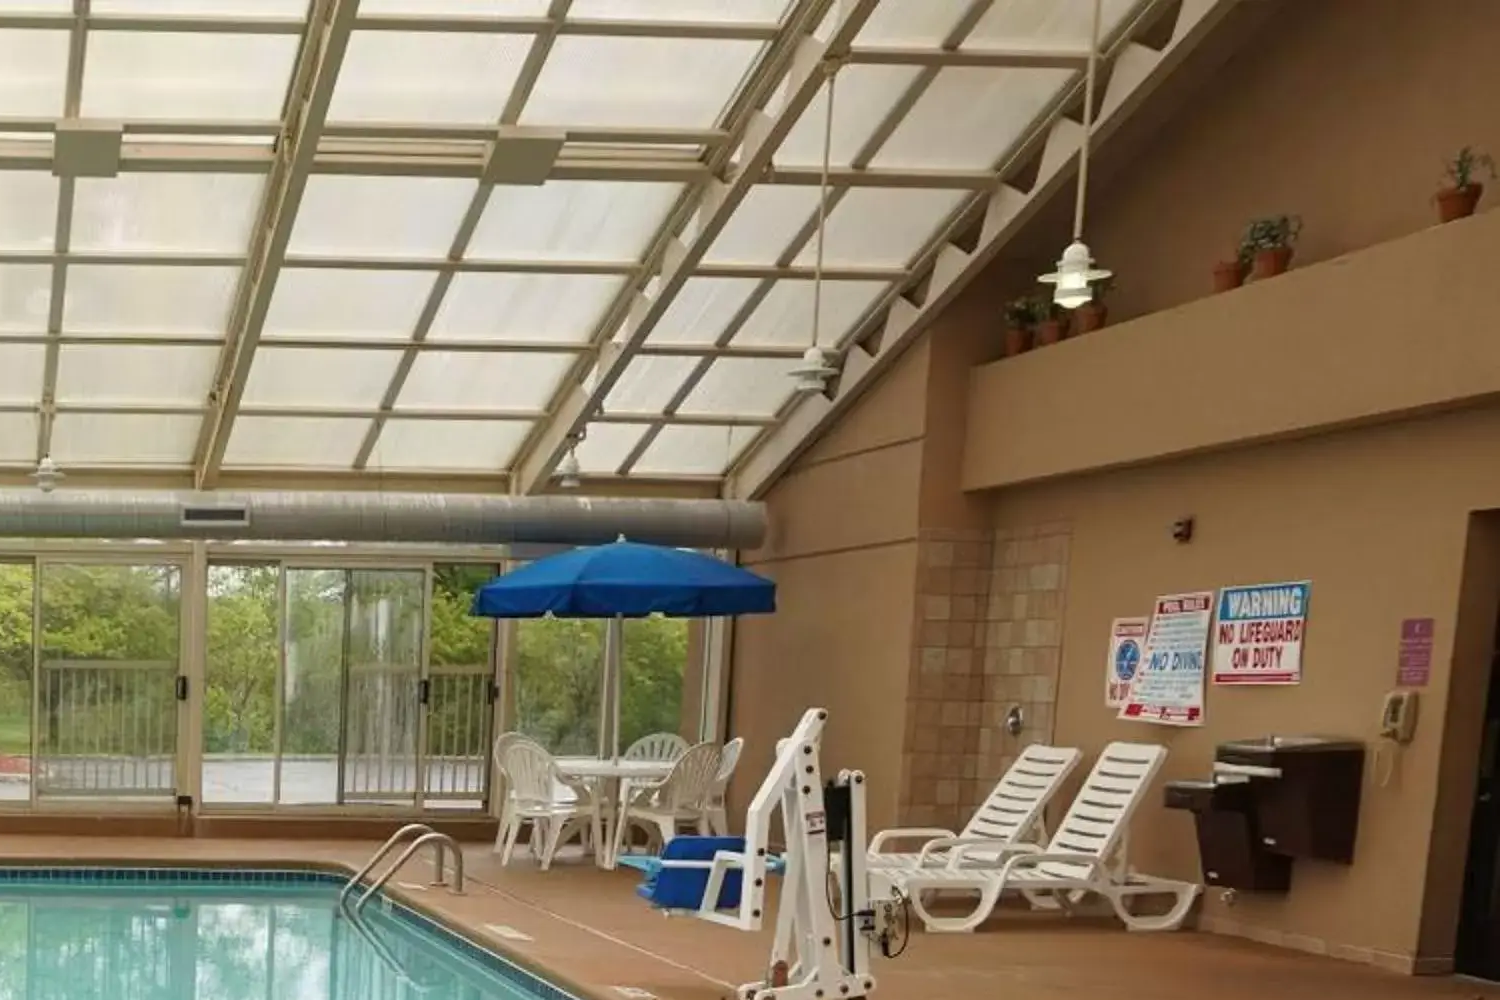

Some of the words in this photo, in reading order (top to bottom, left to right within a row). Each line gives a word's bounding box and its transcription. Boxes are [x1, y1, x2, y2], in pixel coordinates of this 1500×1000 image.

[1227, 586, 1303, 618] WARNING
[1219, 623, 1234, 644] NO
[1239, 619, 1301, 644] LIFEGUARD
[1148, 652, 1169, 671] NO
[1232, 648, 1249, 669] ON
[1252, 645, 1284, 668] DUTY
